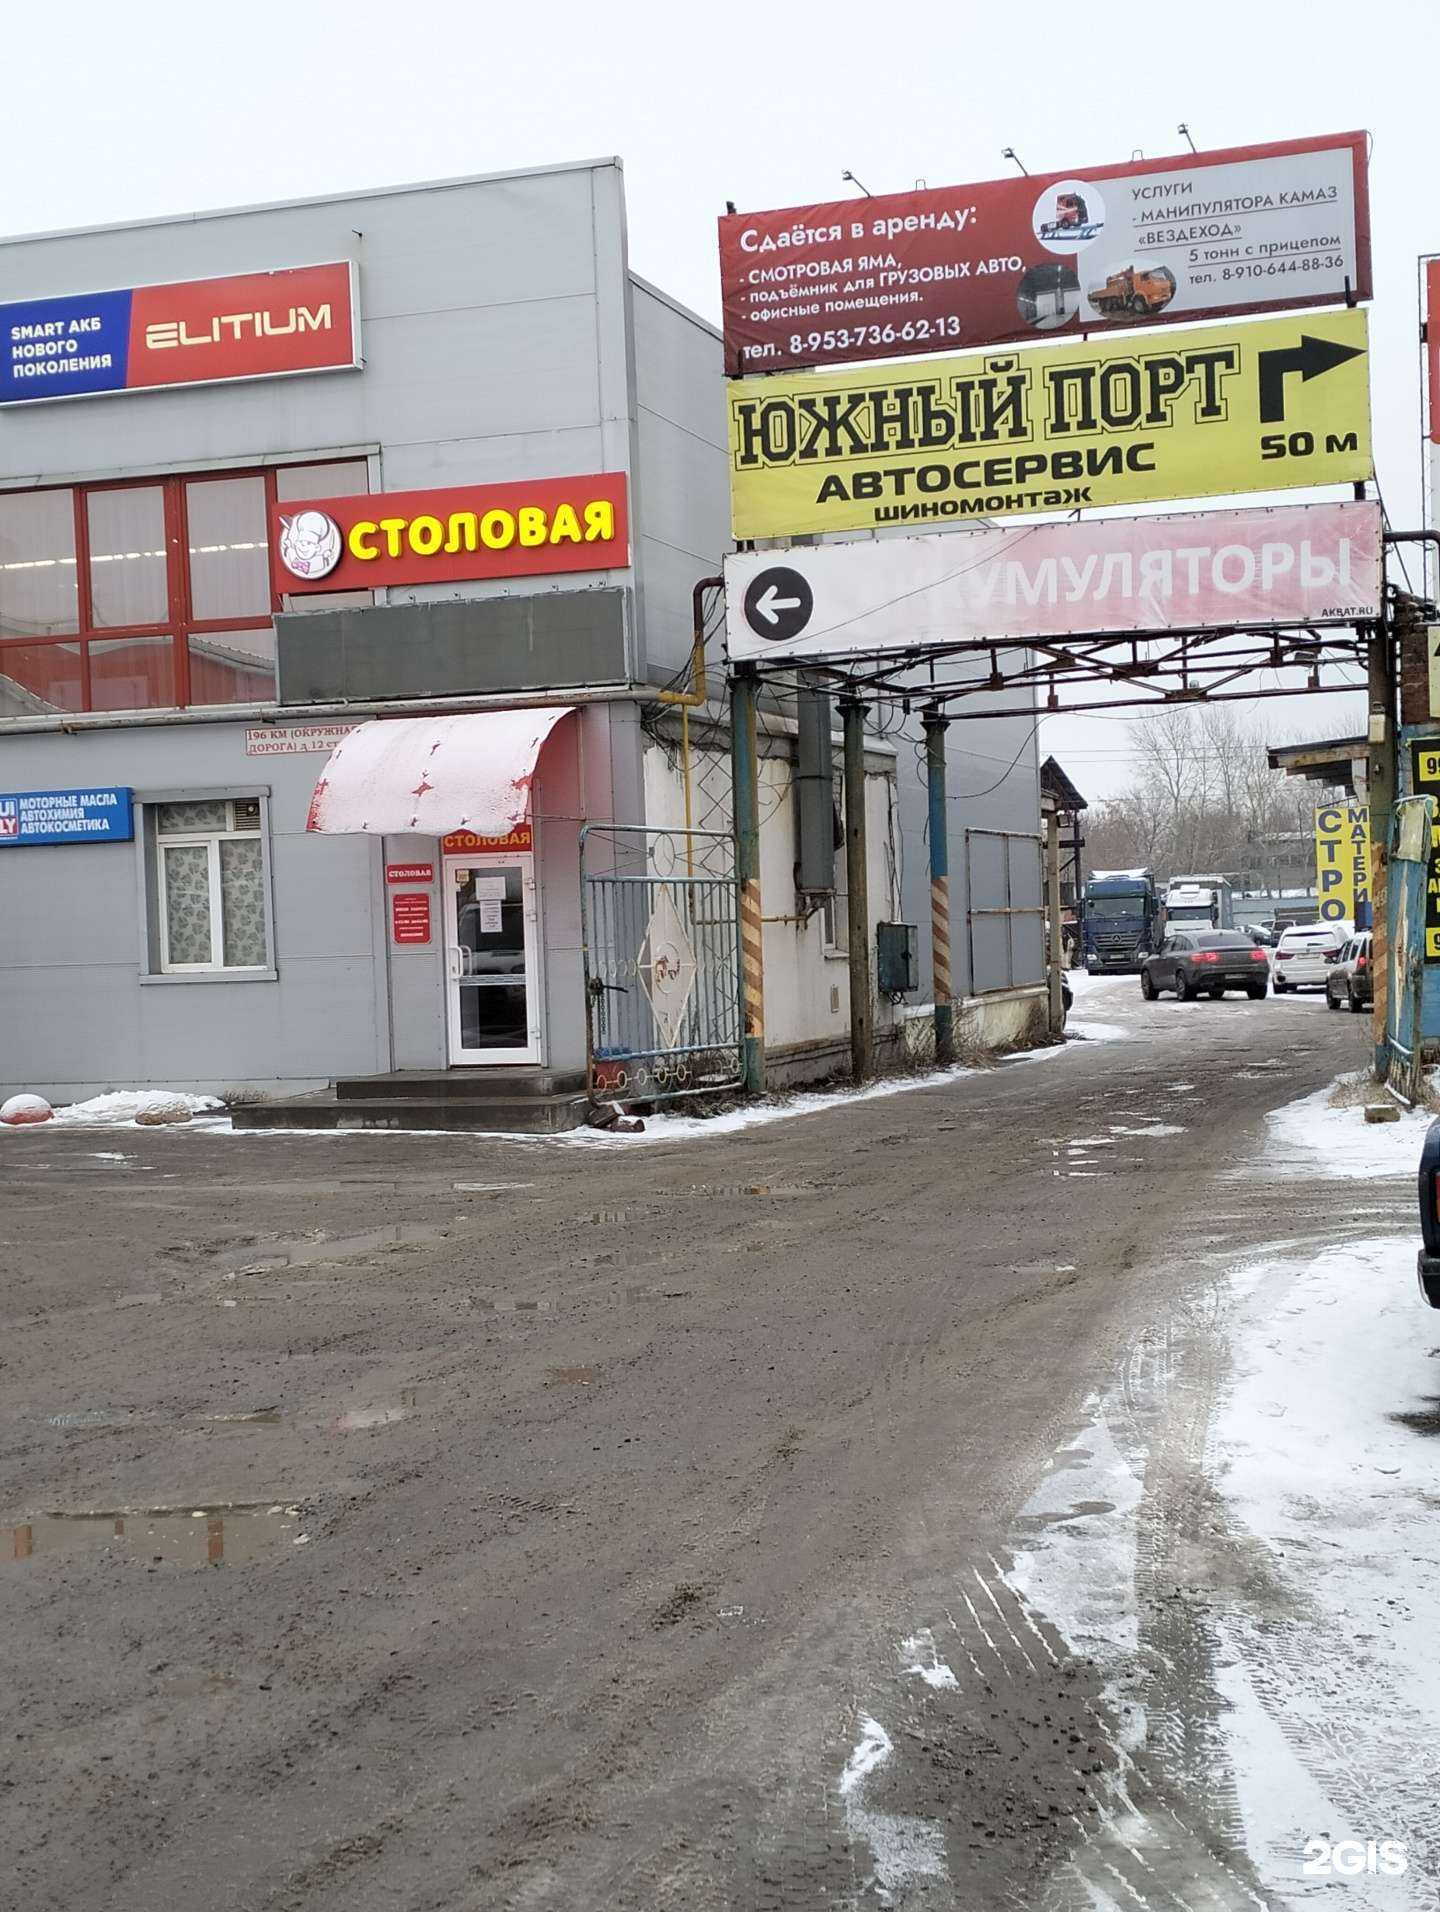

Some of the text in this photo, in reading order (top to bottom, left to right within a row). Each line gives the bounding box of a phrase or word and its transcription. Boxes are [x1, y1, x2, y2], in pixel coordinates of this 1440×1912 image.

[1132, 181, 1193, 201] УСЛУГИ
[1141, 185, 1338, 220] МАНИПУЛЯТОРА КАМАЗ
[740, 206, 977, 252] Сдаётся в аренду:
[1138, 223, 1242, 246] «ВЕЗДЕХОД»
[1188, 235, 1341, 262] 5 тонн с прицепом
[749, 253, 902, 284] СМОТРОВАЯ ЯМА,
[750, 256, 1027, 304] подъёмник для ГРУЗОВЫХ АВТО,
[1189, 255, 1344, 285] тел. 8-910-644-88-36
[750, 291, 924, 322] офисные помещения.
[11, 316, 101, 340] SMART АКБ
[146, 303, 332, 350] ELITIUM
[743, 316, 961, 360] тел. 8-953-736-62-13
[12, 339, 78, 359] НОВОГО
[13, 354, 112, 378] ПОКОЛЕНИЯ
[735, 347, 1239, 468] ЮЖНЫЙ ПОРТ
[1261, 432, 1313, 460] 50
[816, 441, 1157, 504] АВТОСЕРВИС
[347, 499, 615, 561] СТОЛОВАЯ
[955, 537, 1353, 604] УМУЛЯТОРЫ
[270, 730, 287, 739] КМ
[291, 726, 356, 739] (ОКРУЖНА
[20, 794, 118, 810] МОТОРНЫЕ МАСЛА
[21, 808, 85, 822] АВТОХИМИЯ
[21, 819, 110, 834] АВТОКОСМЕТИКА
[444, 832, 531, 848] СТОЛОВАЯ
